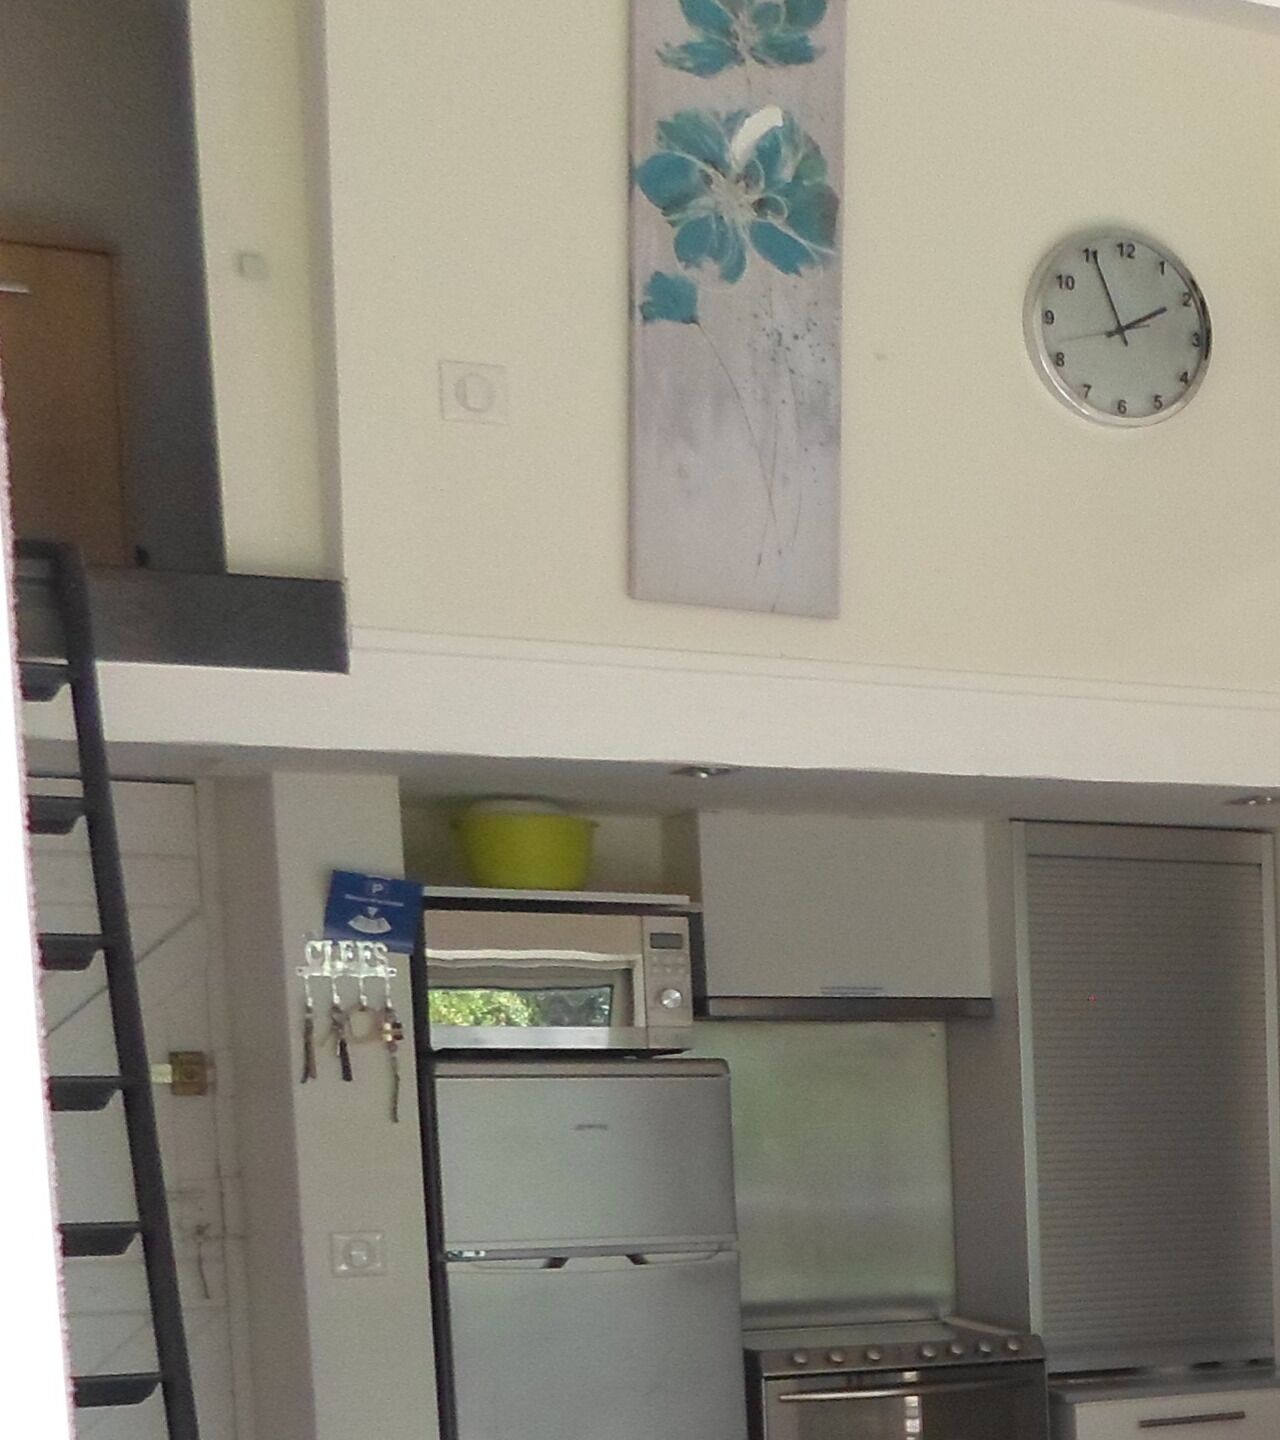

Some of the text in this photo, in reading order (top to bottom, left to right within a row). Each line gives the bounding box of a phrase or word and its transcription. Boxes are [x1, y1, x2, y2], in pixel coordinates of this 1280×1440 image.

[1083, 248, 1099, 263] 11
[1116, 242, 1136, 259] 12
[1158, 261, 1166, 276] 1
[1056, 274, 1076, 290] 10
[1182, 292, 1192, 308] 2
[1044, 310, 1055, 325] 9
[1192, 332, 1201, 347] 3
[1056, 352, 1065, 367] 8
[1180, 371, 1189, 386] 4
[1083, 384, 1092, 399] 7
[1117, 400, 1128, 414] 6
[1154, 395, 1163, 410] 5
